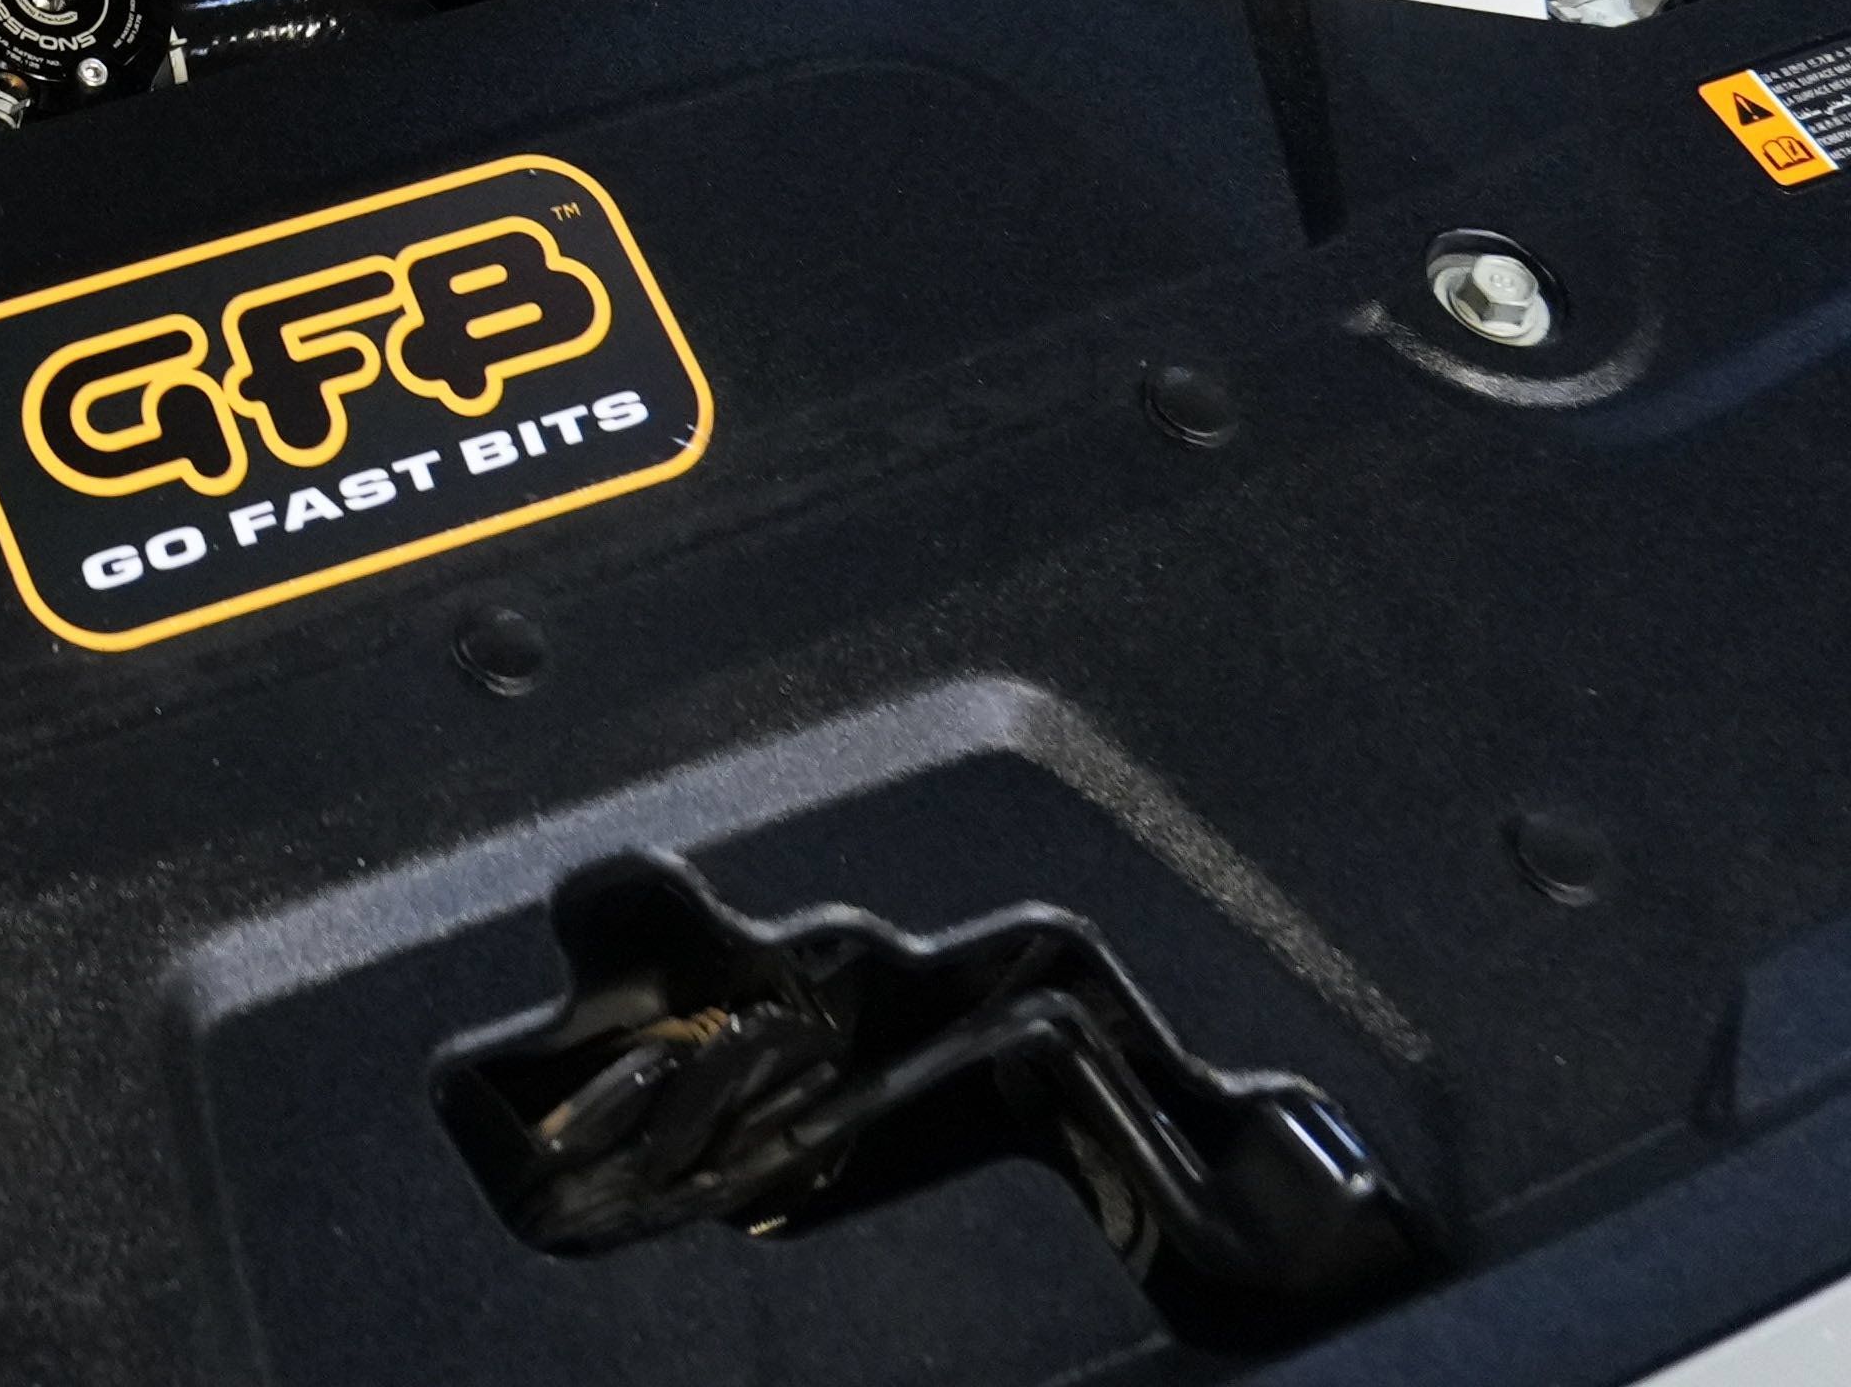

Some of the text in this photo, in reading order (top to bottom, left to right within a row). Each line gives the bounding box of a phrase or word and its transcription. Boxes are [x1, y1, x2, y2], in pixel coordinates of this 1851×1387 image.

[8, 47, 44, 62] PATENT
[21, 215, 613, 498] GFB
[82, 390, 652, 593] GO FAST BITS
